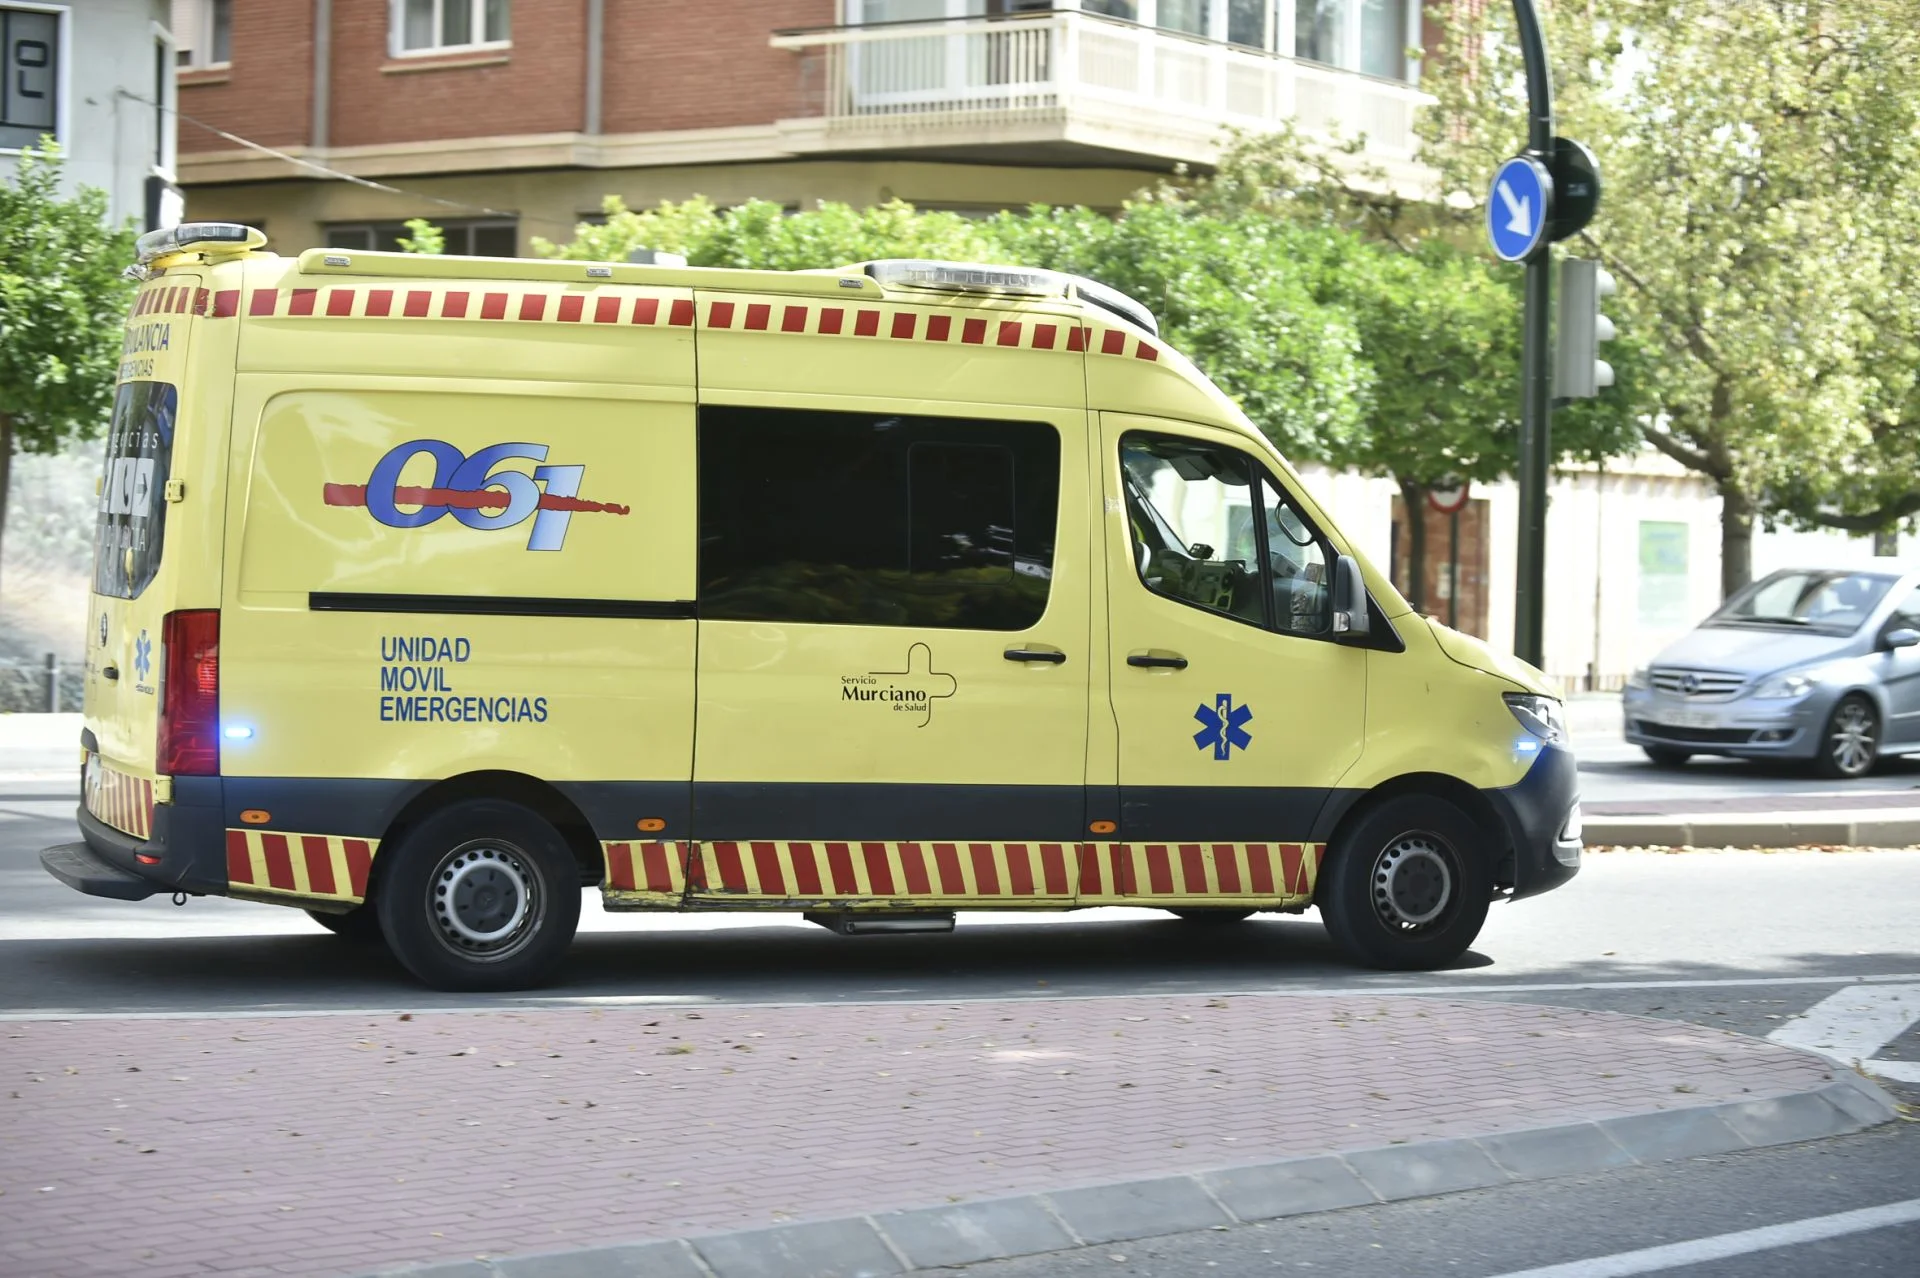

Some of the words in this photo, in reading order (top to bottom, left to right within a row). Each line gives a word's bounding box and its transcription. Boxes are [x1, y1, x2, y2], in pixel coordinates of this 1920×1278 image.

[365, 439, 585, 551] 061
[381, 636, 470, 662] UNIDAD
[381, 666, 452, 692] MOVIL
[841, 676, 877, 684] Servicio
[842, 684, 926, 701] Murciano
[380, 697, 548, 722] EMERGENCIAS
[893, 703, 903, 711] de
[905, 703, 926, 711] Salud
